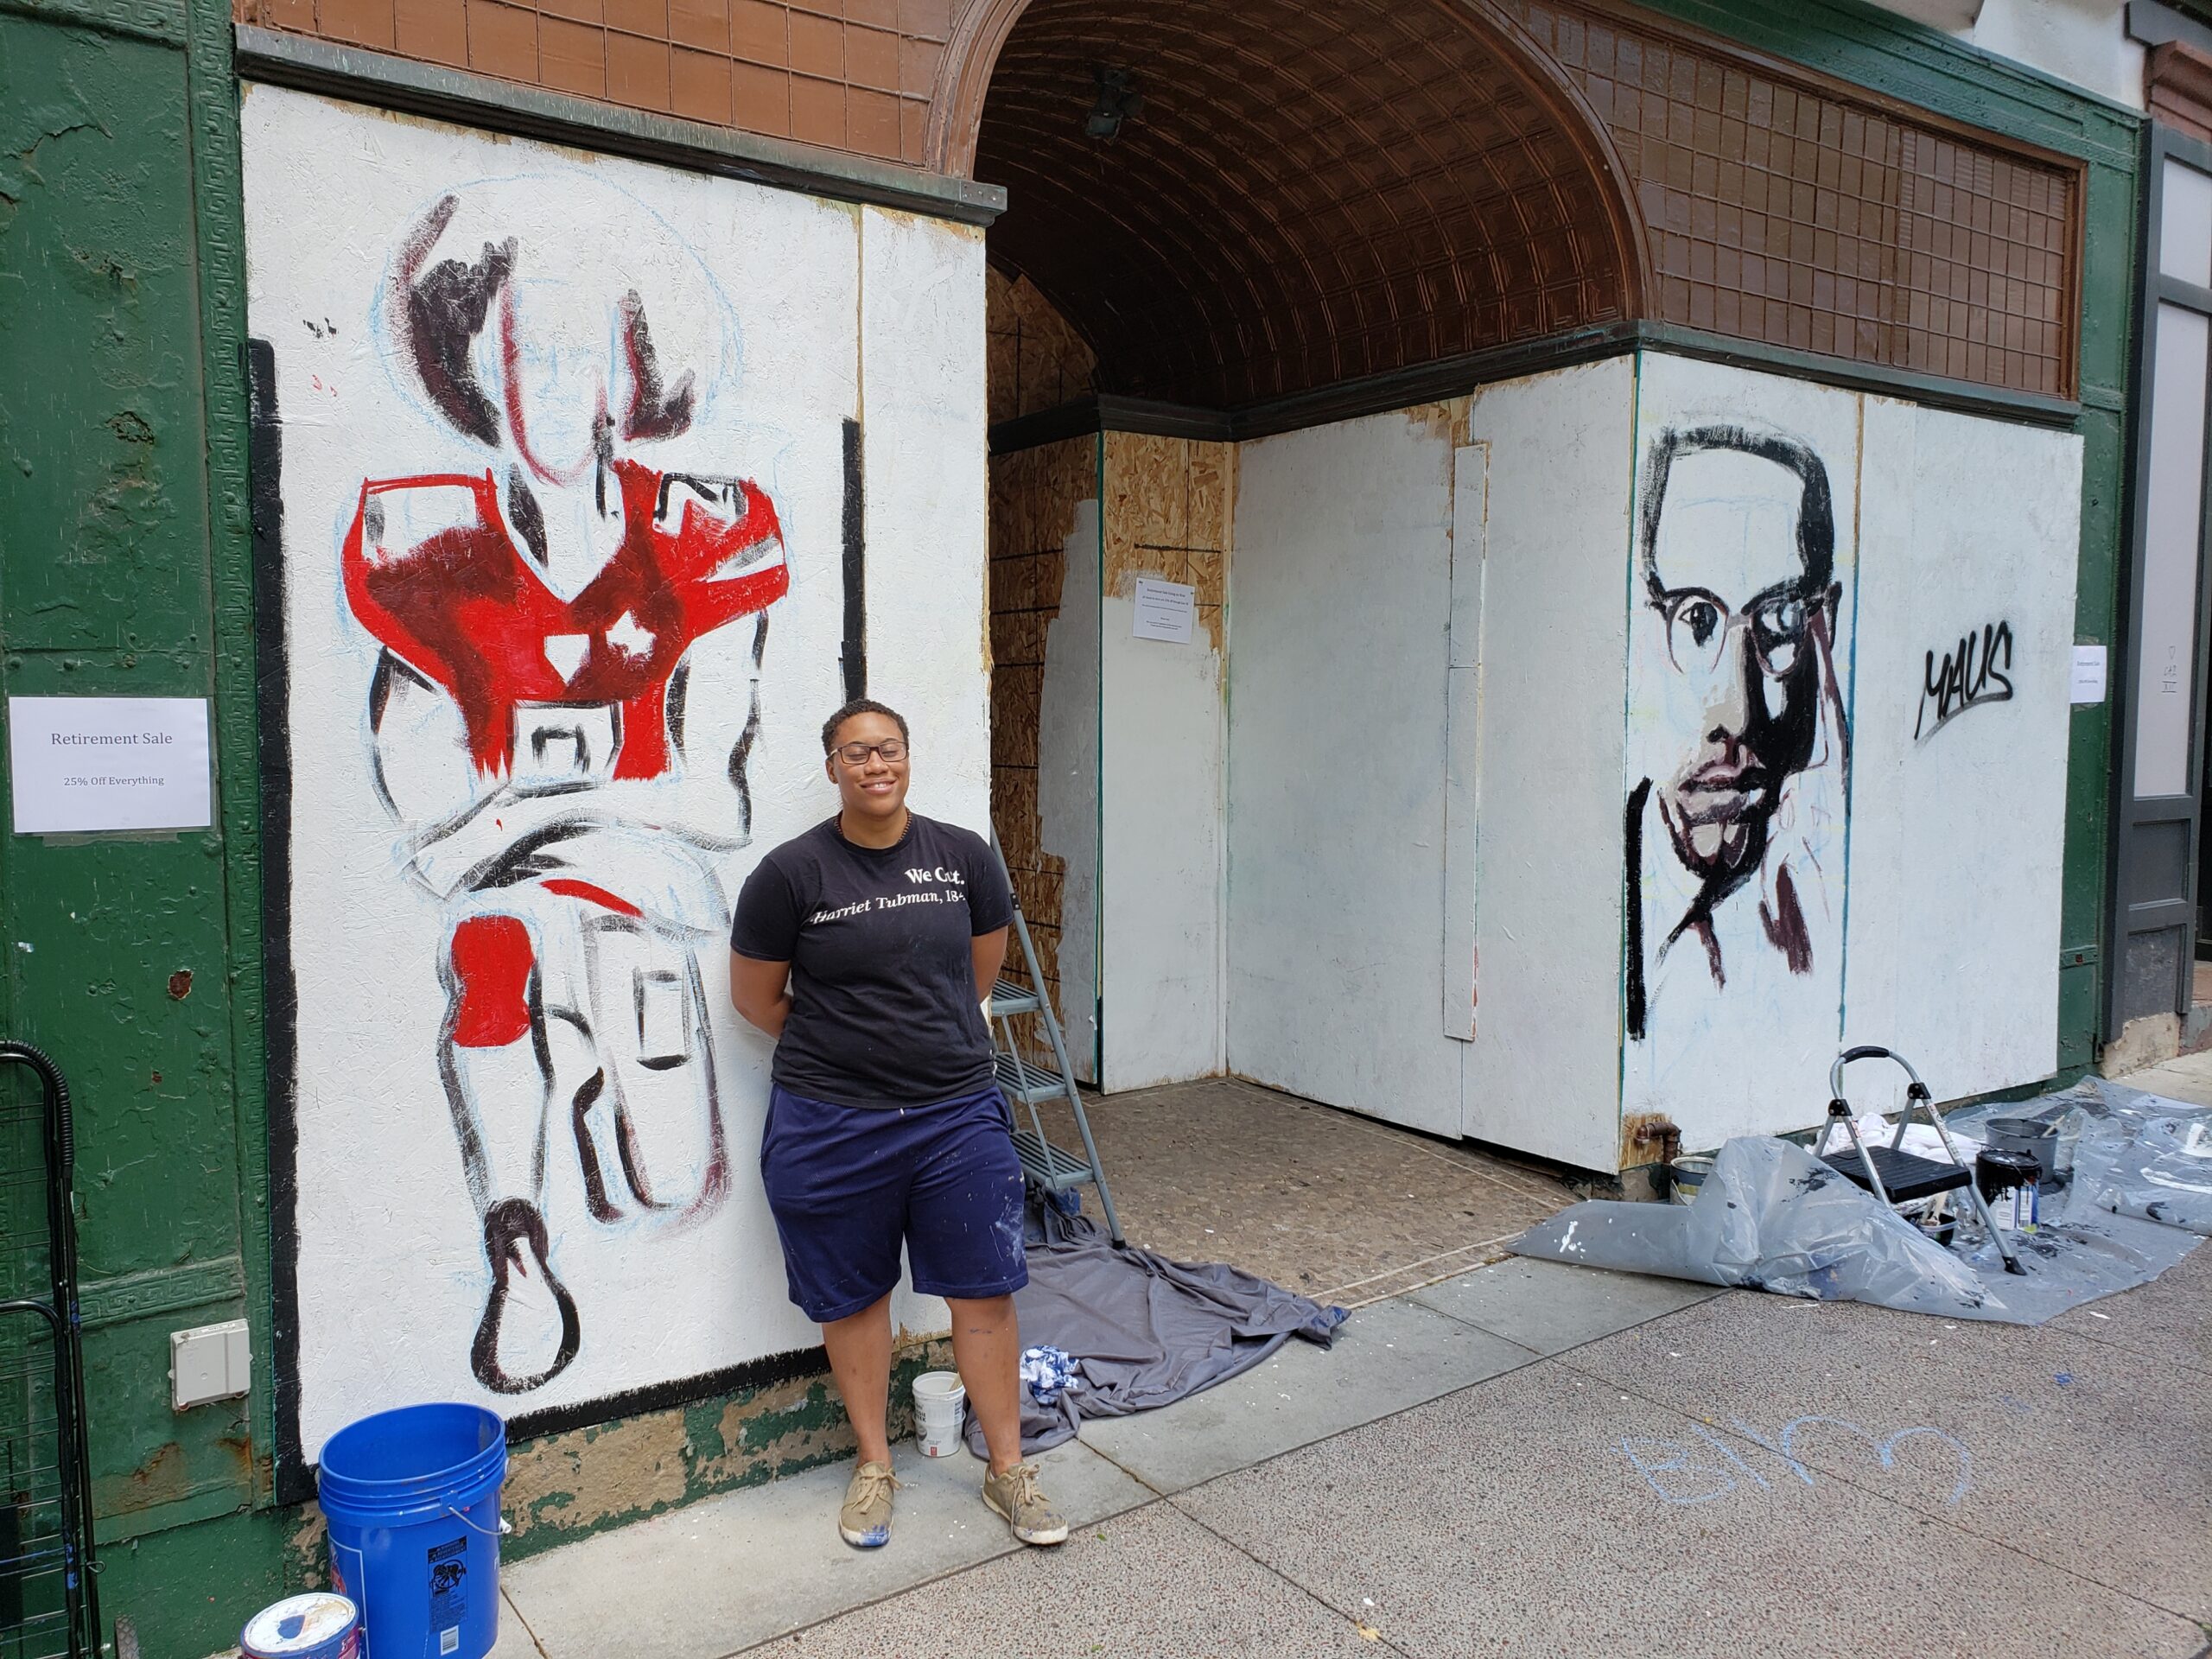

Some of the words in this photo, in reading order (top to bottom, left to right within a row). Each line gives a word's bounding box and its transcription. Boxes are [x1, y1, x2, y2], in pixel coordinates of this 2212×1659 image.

[51, 732, 139, 745] Retirement
[143, 732, 173, 745] Sale
[64, 777, 88, 786] 25%
[91, 776, 107, 785] Off
[108, 776, 165, 787] Everything
[904, 868, 932, 884] We
[875, 891, 944, 909] Tubman,
